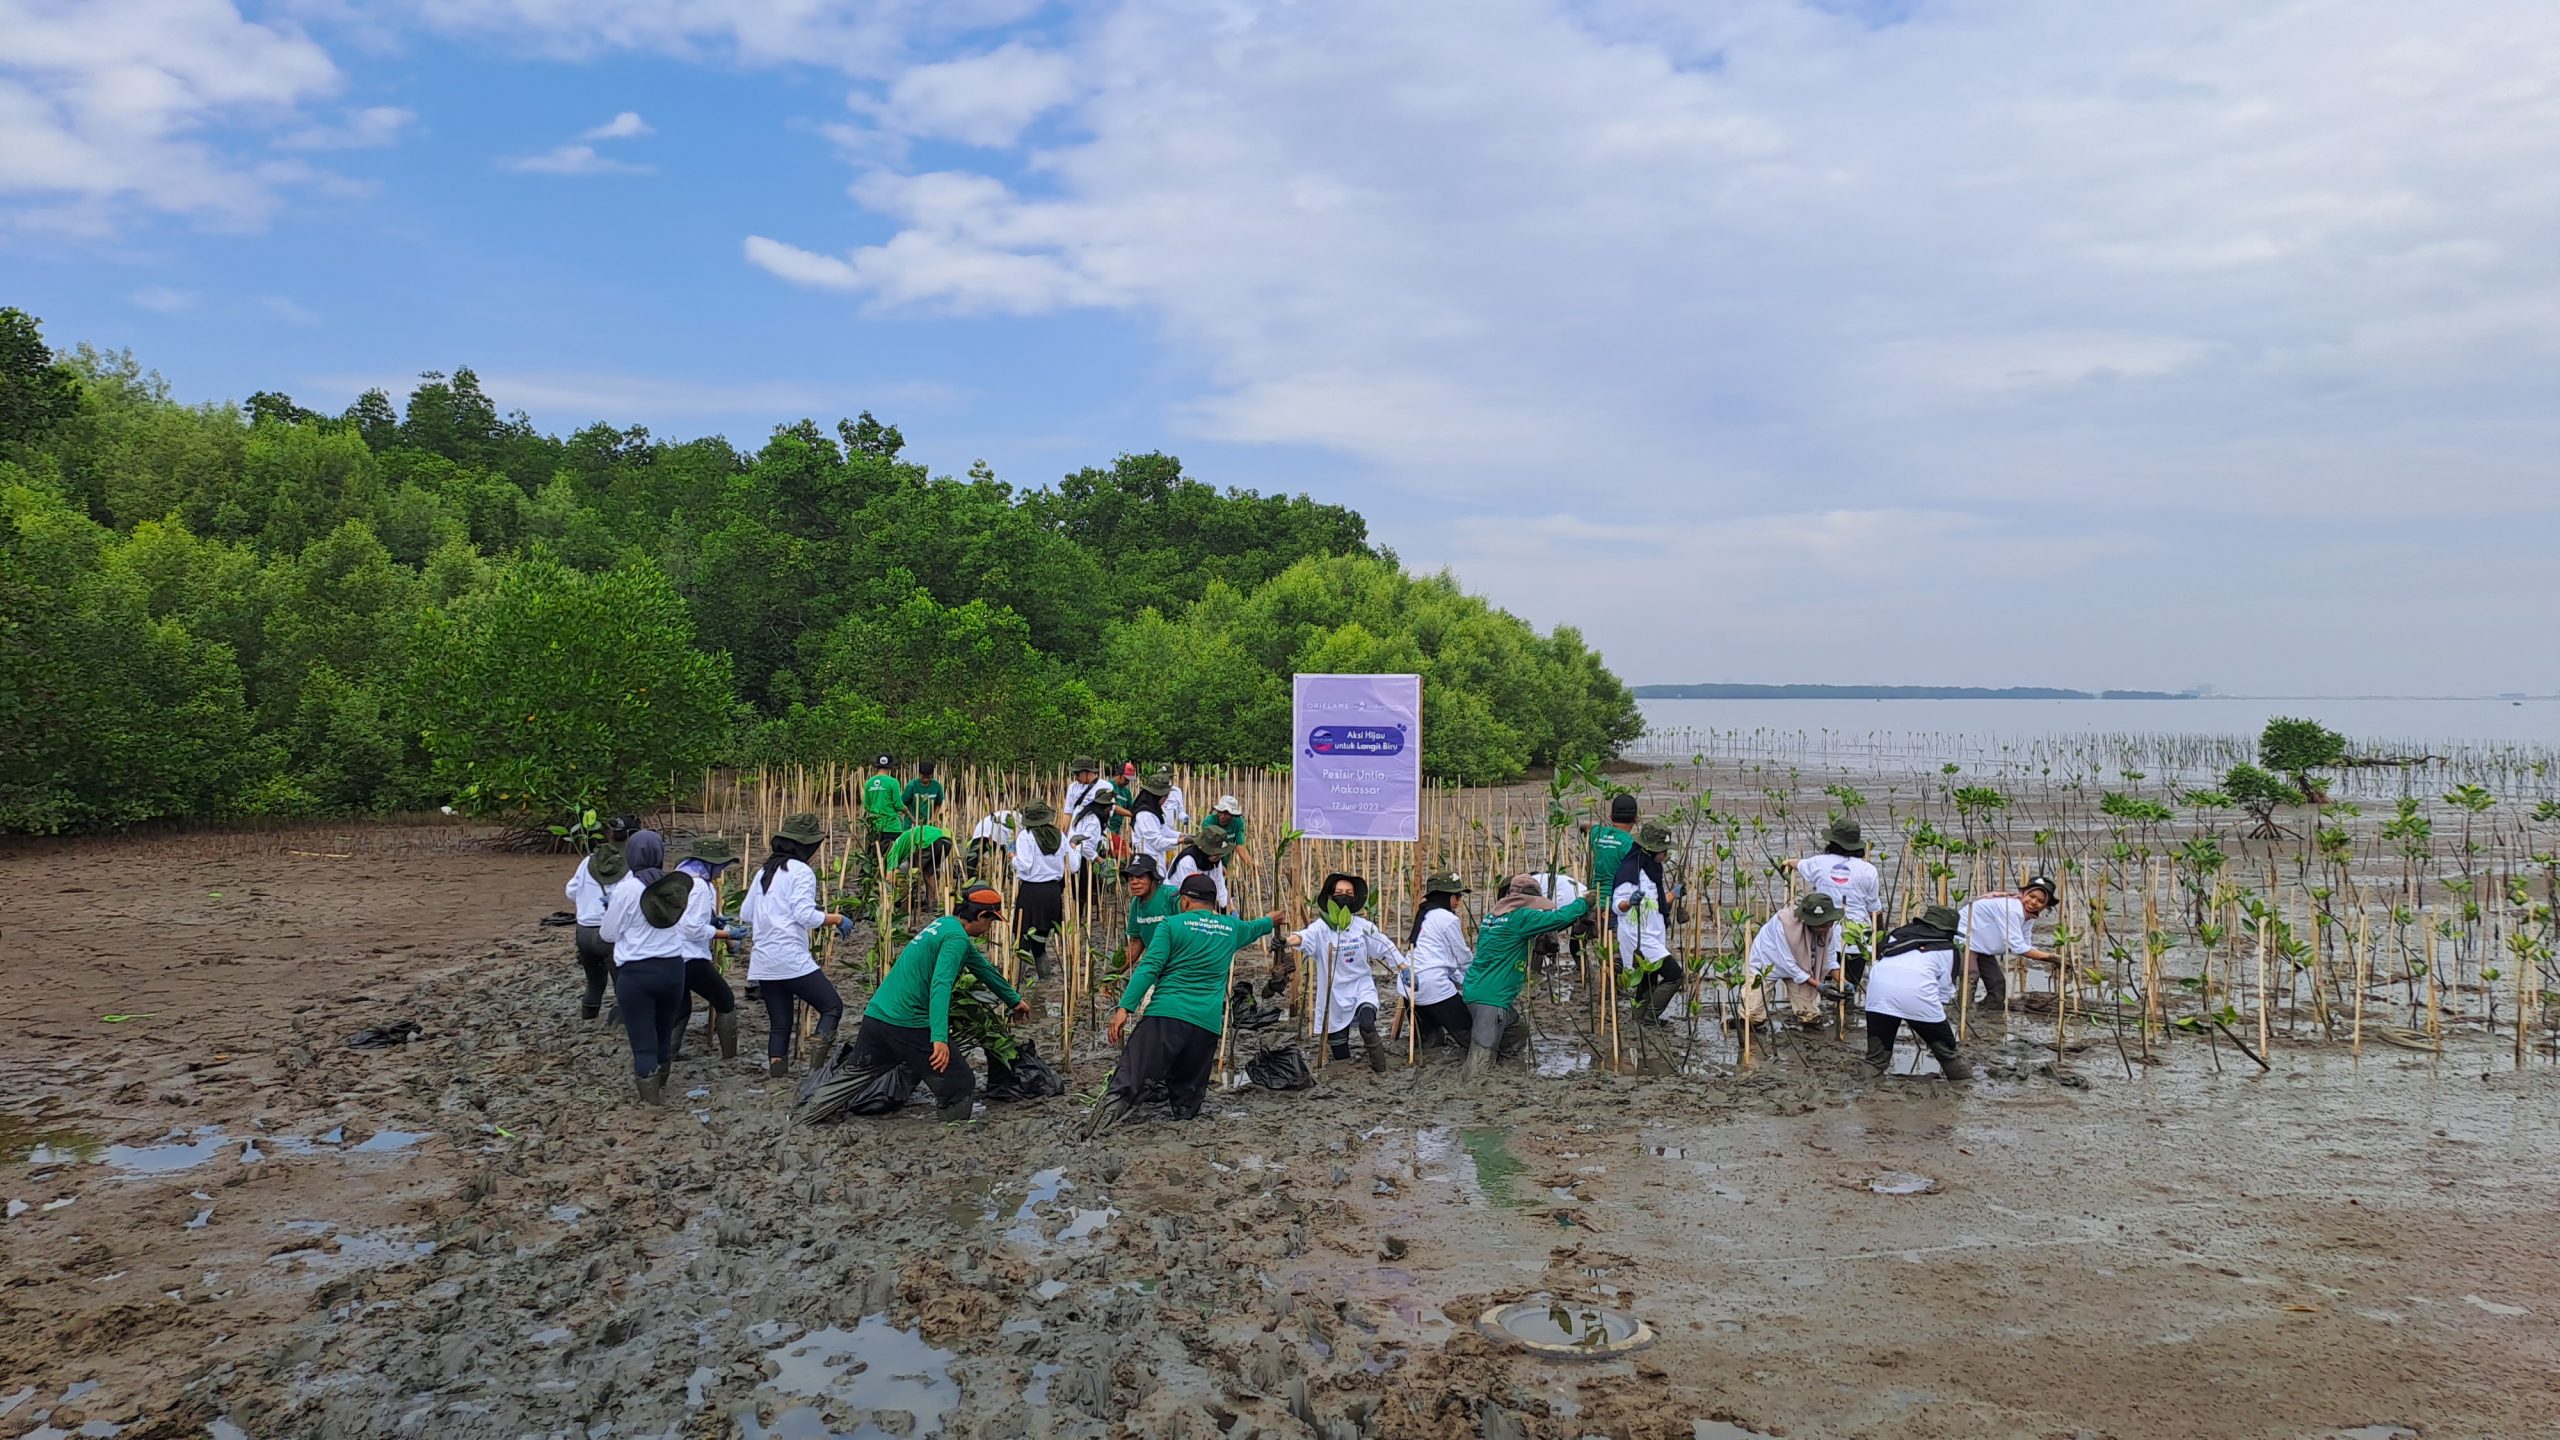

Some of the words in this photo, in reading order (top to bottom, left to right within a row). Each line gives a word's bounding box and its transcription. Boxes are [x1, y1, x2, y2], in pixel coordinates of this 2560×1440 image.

[1347, 731, 1364, 740] Aksi
[1365, 731, 1386, 741] Hijau
[1334, 742, 1355, 750] untuk
[1357, 742, 1381, 752] Langit
[1383, 742, 1398, 750] Biru
[1322, 768, 1354, 780] Pesisir
[1330, 783, 1381, 794] Makassar
[1332, 802, 1340, 810] 17
[1342, 802, 1356, 811] Juni
[1359, 802, 1379, 811] 2023
